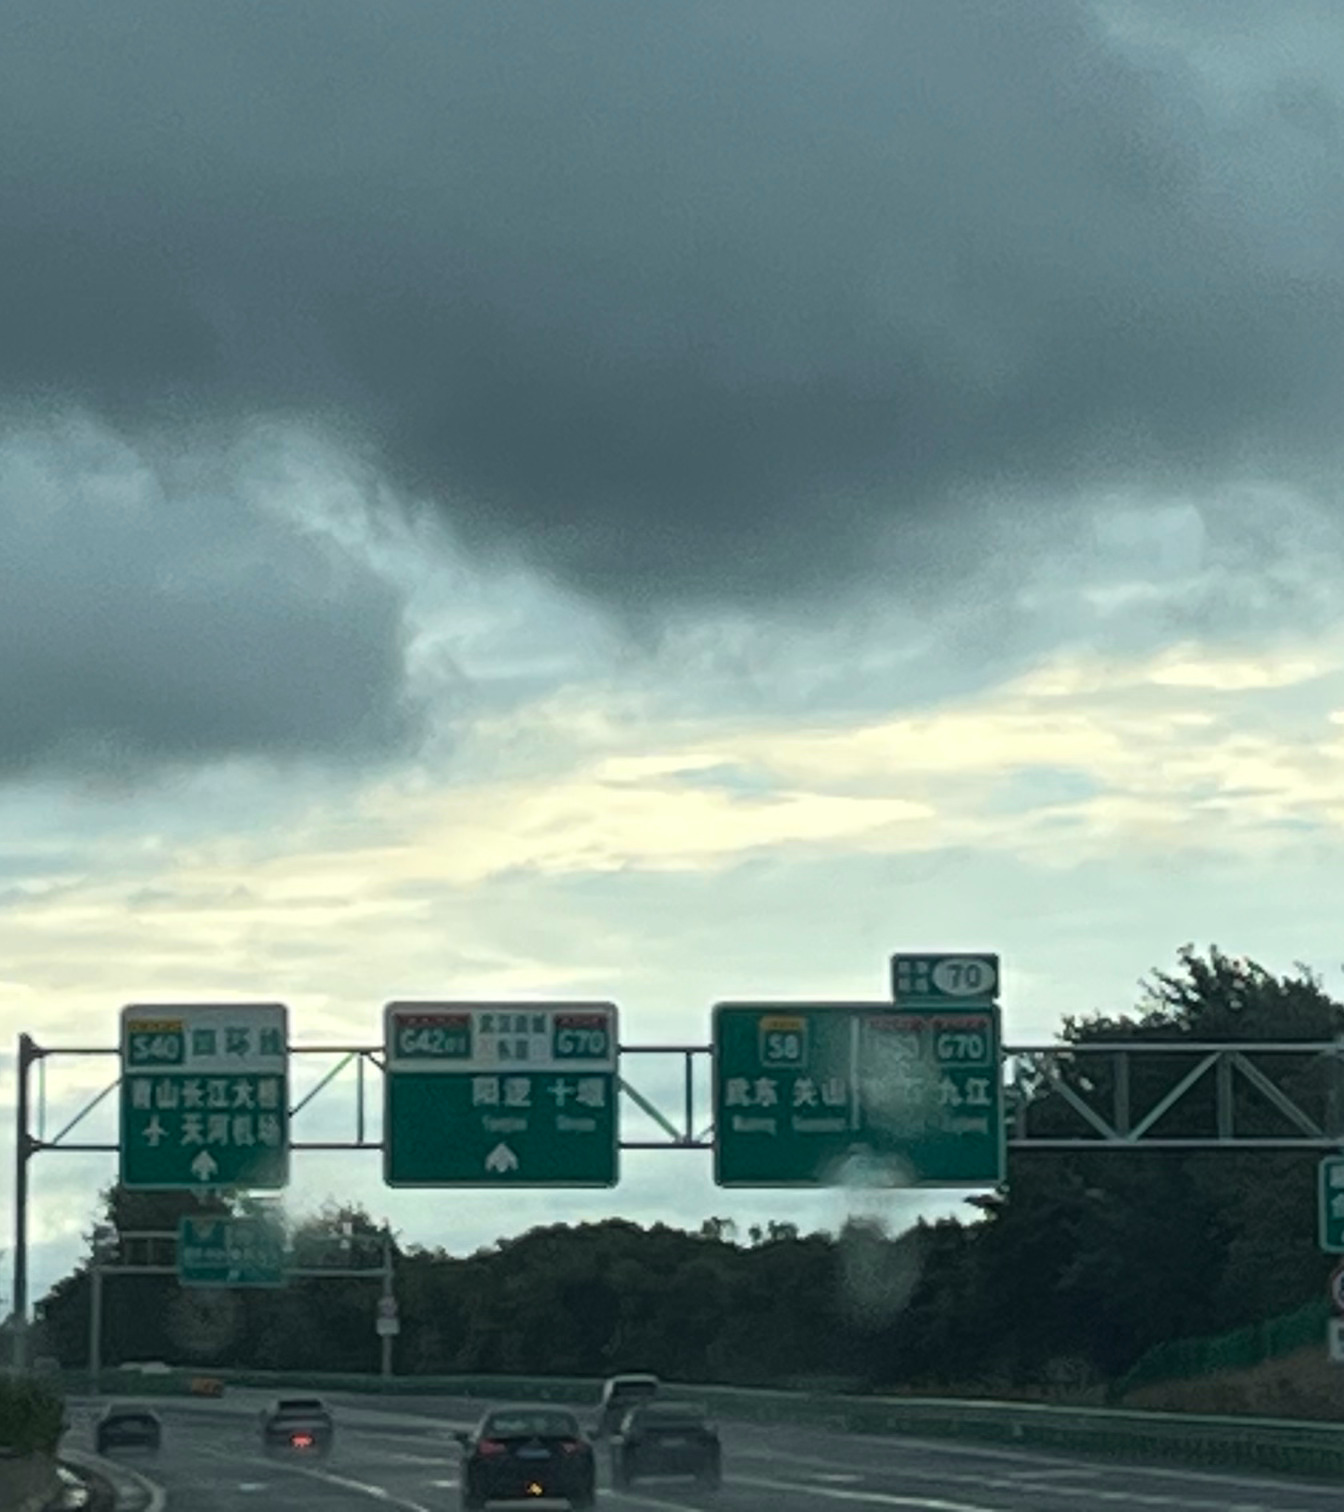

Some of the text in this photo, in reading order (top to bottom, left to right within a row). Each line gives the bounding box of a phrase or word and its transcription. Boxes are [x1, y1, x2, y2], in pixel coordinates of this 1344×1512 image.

[947, 964, 981, 986] 70
[132, 1034, 180, 1059] S40
[557, 1028, 605, 1053] G70
[937, 1033, 984, 1059] G70
